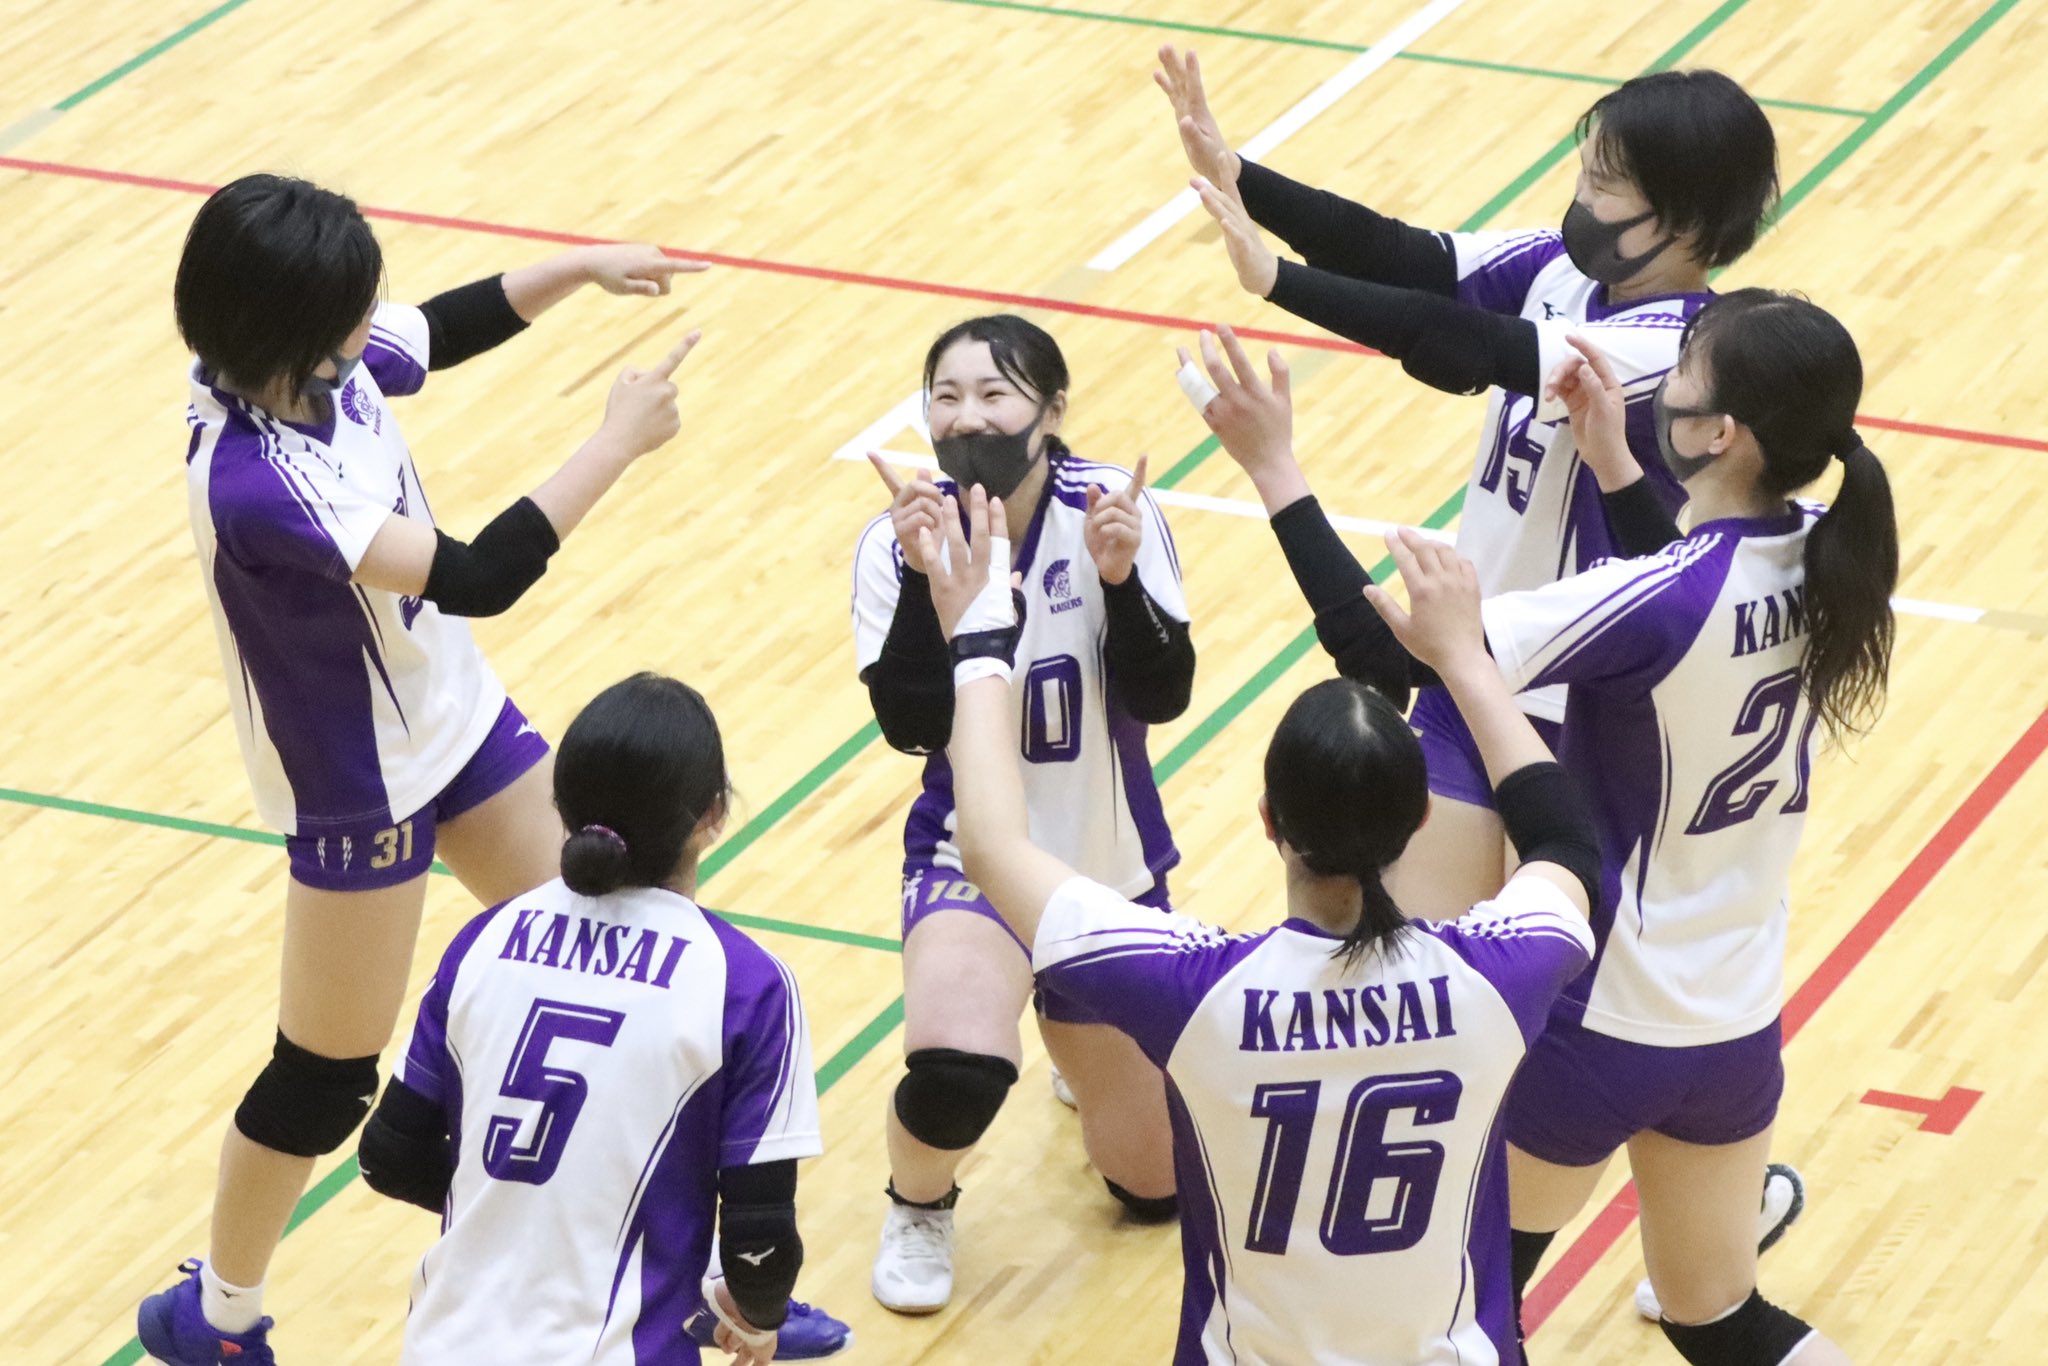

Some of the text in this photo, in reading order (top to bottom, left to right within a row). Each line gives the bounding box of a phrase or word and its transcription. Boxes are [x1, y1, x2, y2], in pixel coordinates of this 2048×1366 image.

[1479, 391, 1569, 516] 15
[1050, 597, 1082, 614] KAISERS
[1731, 586, 1810, 657] KAN
[370, 820, 413, 869] 31
[926, 880, 980, 905] 10
[499, 910, 691, 989] KANSAI
[1239, 975, 1456, 1051] KANSAI
[483, 998, 626, 1185] 5
[1244, 1070, 1463, 1256] 16
